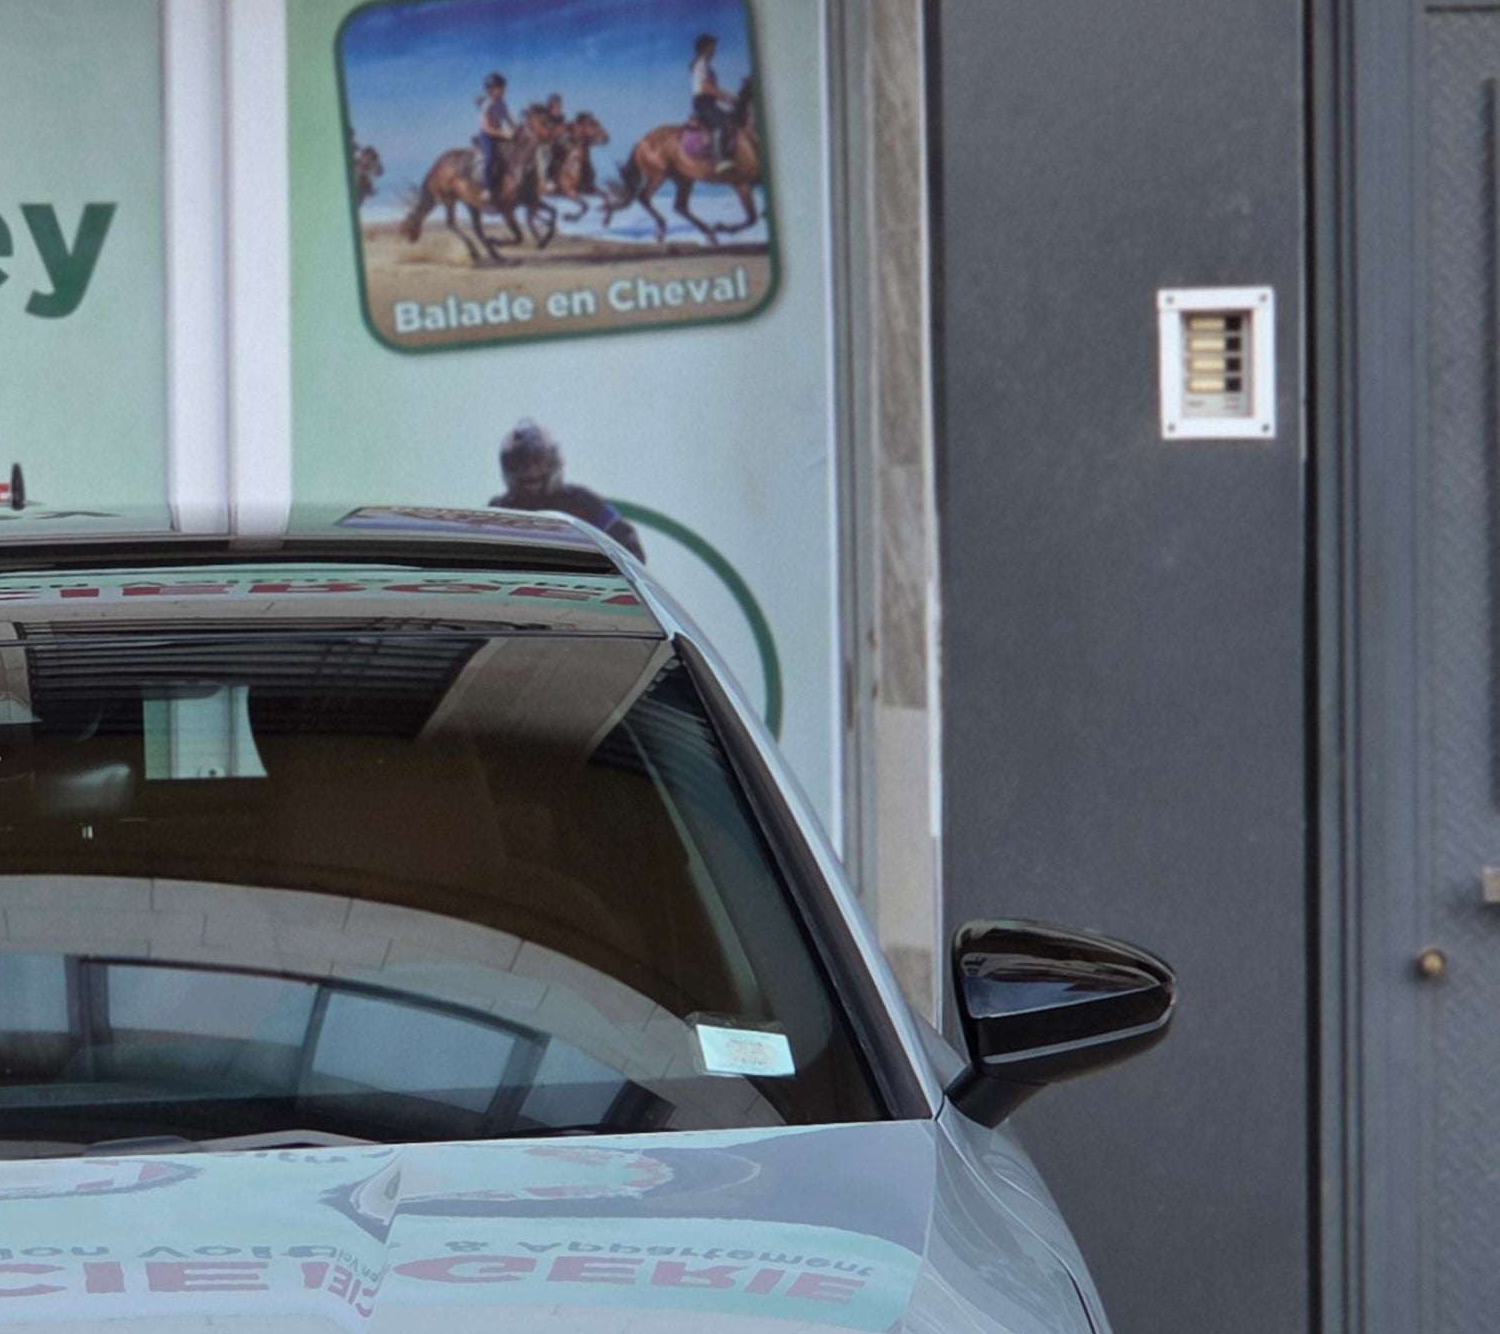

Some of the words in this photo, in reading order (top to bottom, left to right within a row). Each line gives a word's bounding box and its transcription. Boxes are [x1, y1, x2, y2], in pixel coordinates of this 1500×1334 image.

[395, 292, 533, 334] Balade
[547, 287, 596, 318] en
[607, 269, 747, 312] Cheval
